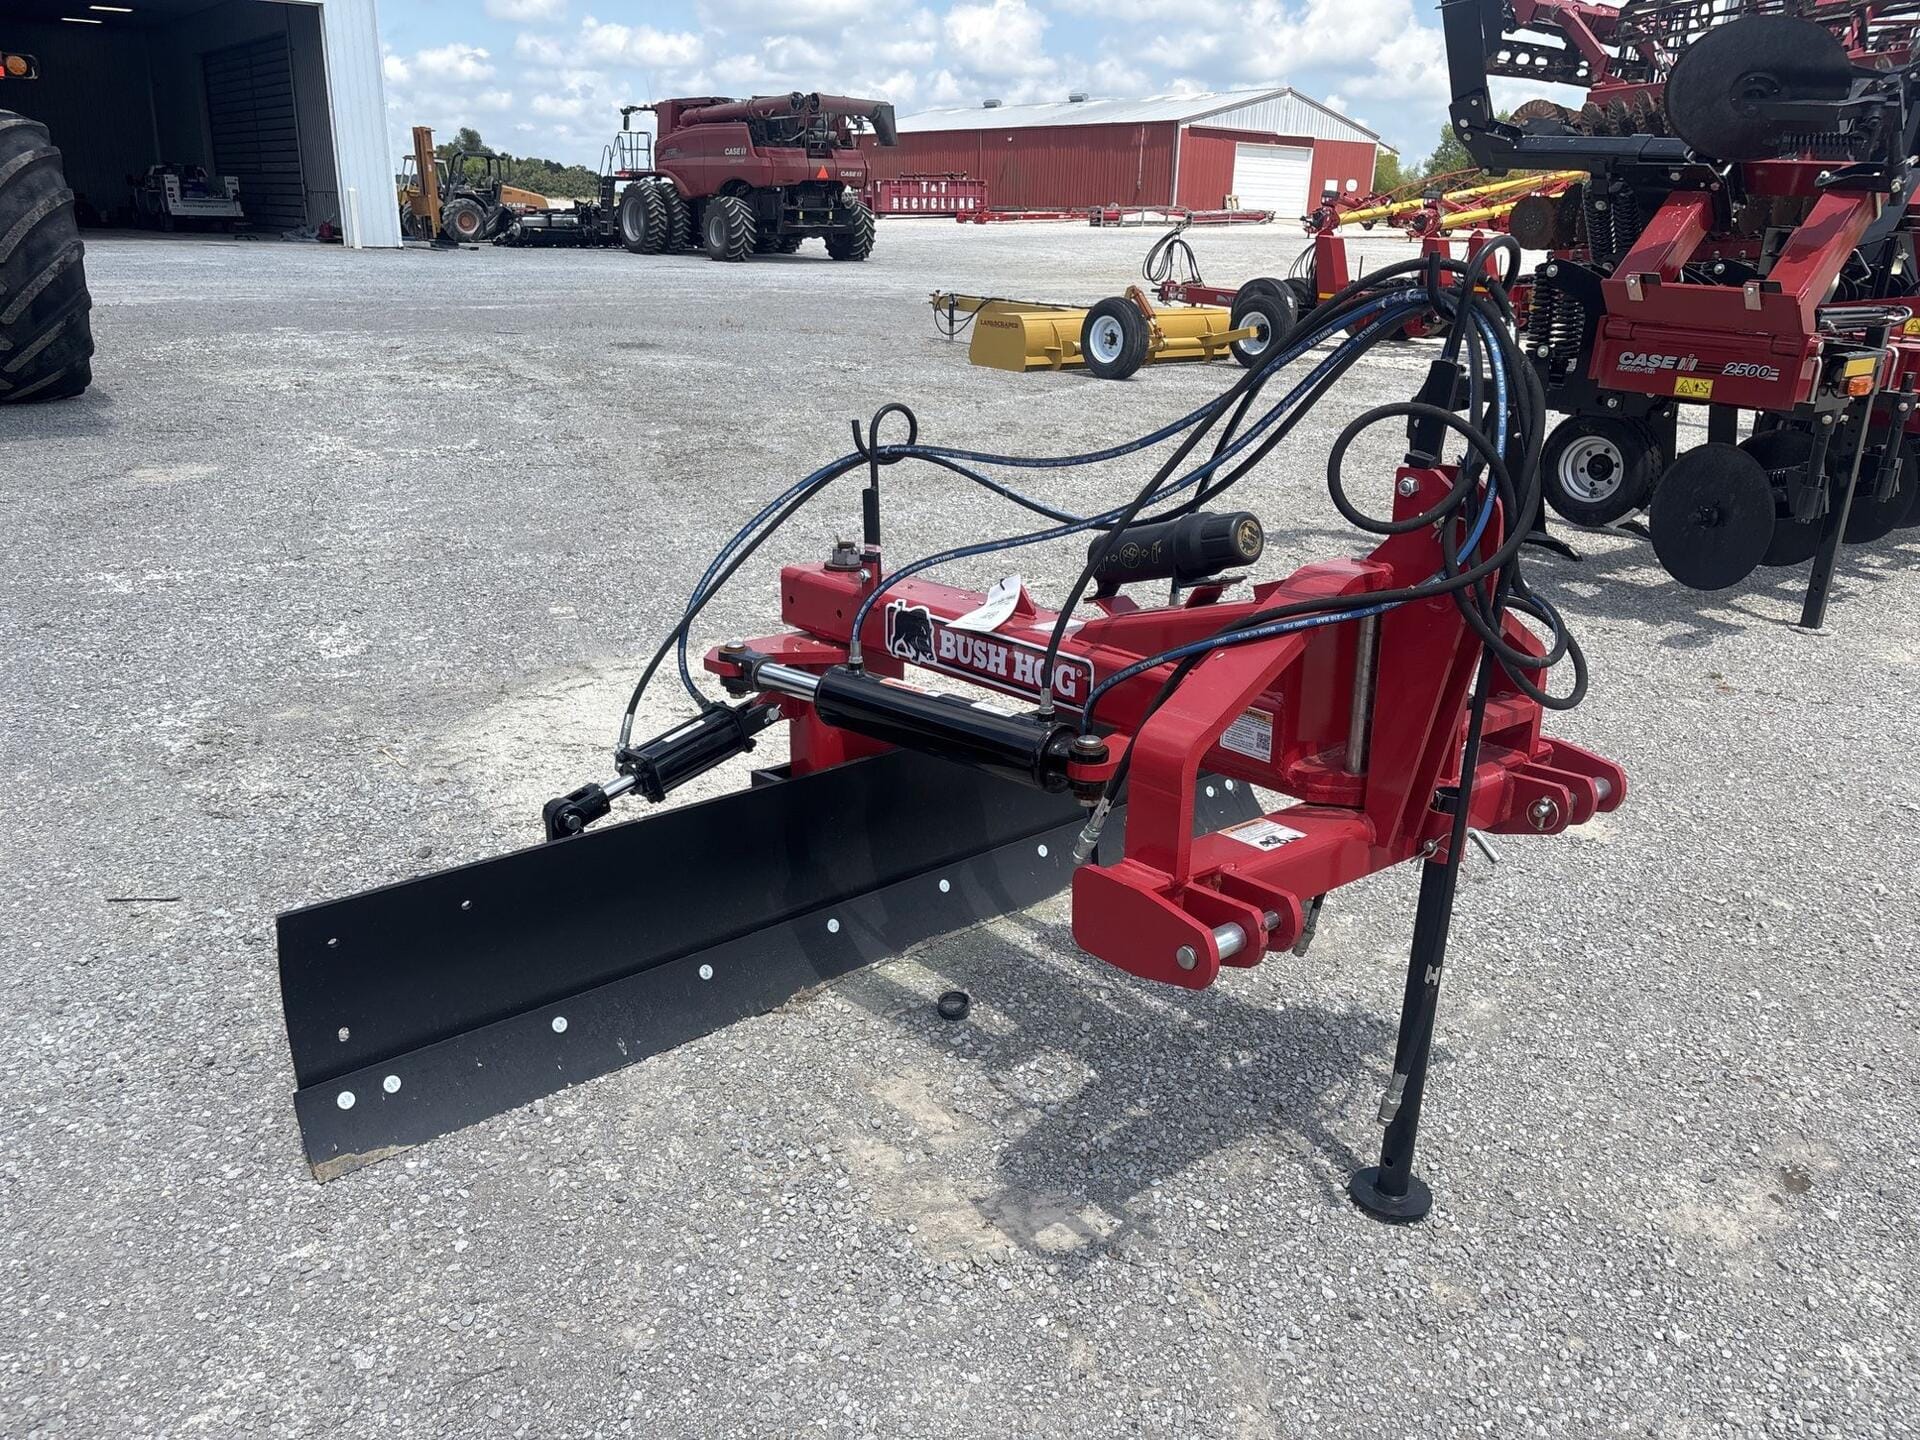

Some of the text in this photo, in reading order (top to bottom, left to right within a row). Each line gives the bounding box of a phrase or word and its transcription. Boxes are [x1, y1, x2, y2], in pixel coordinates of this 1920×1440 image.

[724, 147, 740, 155] CASE
[893, 197, 974, 209] RECYCLING
[1619, 351, 1677, 370] CASE
[1722, 362, 1771, 379] 2500
[939, 629, 1008, 676] BUSH
